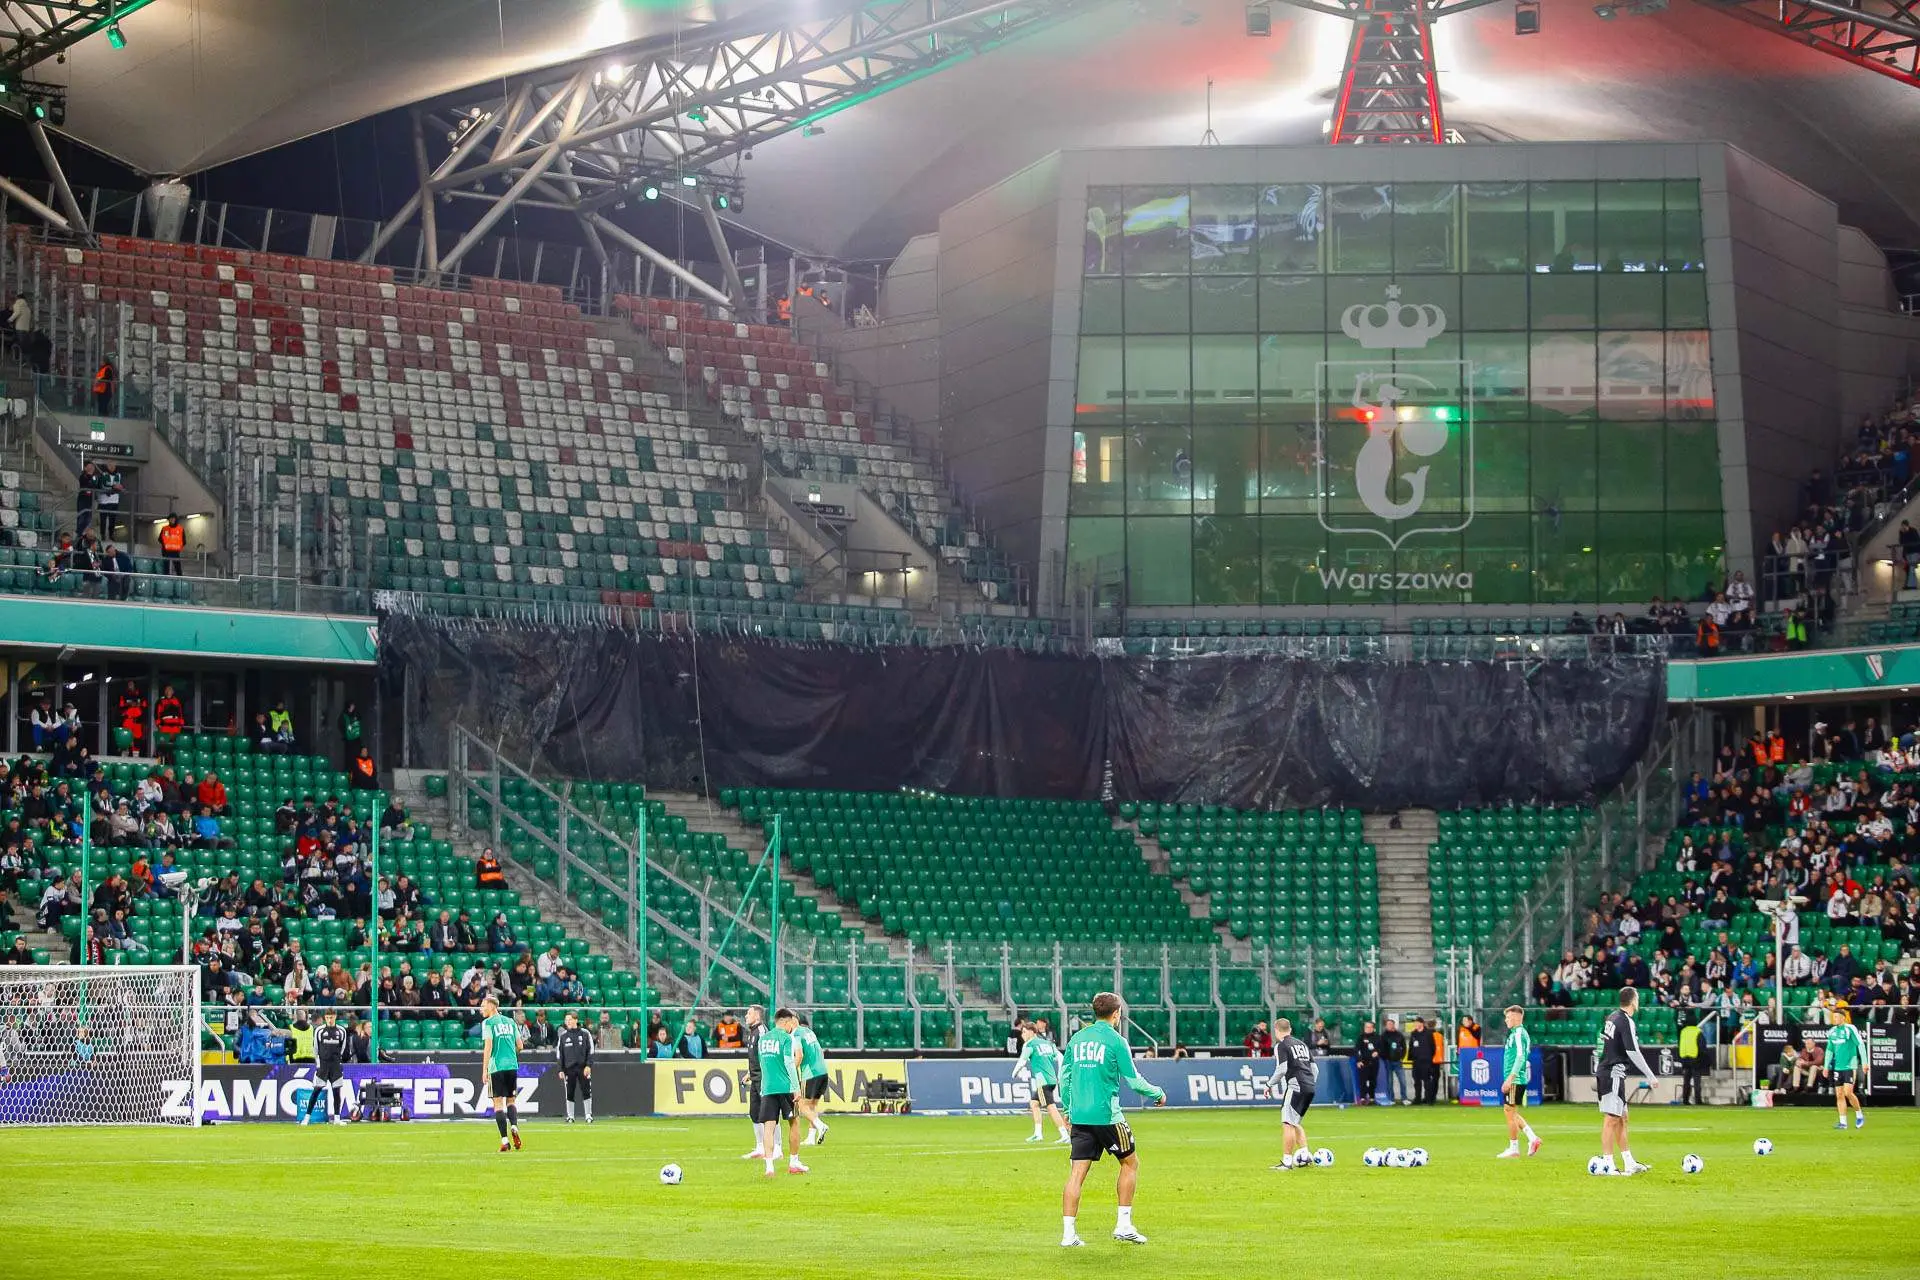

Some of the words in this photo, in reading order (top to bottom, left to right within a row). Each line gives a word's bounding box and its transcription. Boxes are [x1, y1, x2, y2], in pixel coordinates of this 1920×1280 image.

[1318, 567, 1473, 589] Warszawa
[1073, 1040, 1106, 1065] LEGIA
[673, 1069, 869, 1104] FONA
[1187, 1074, 1288, 1101] Plus50
